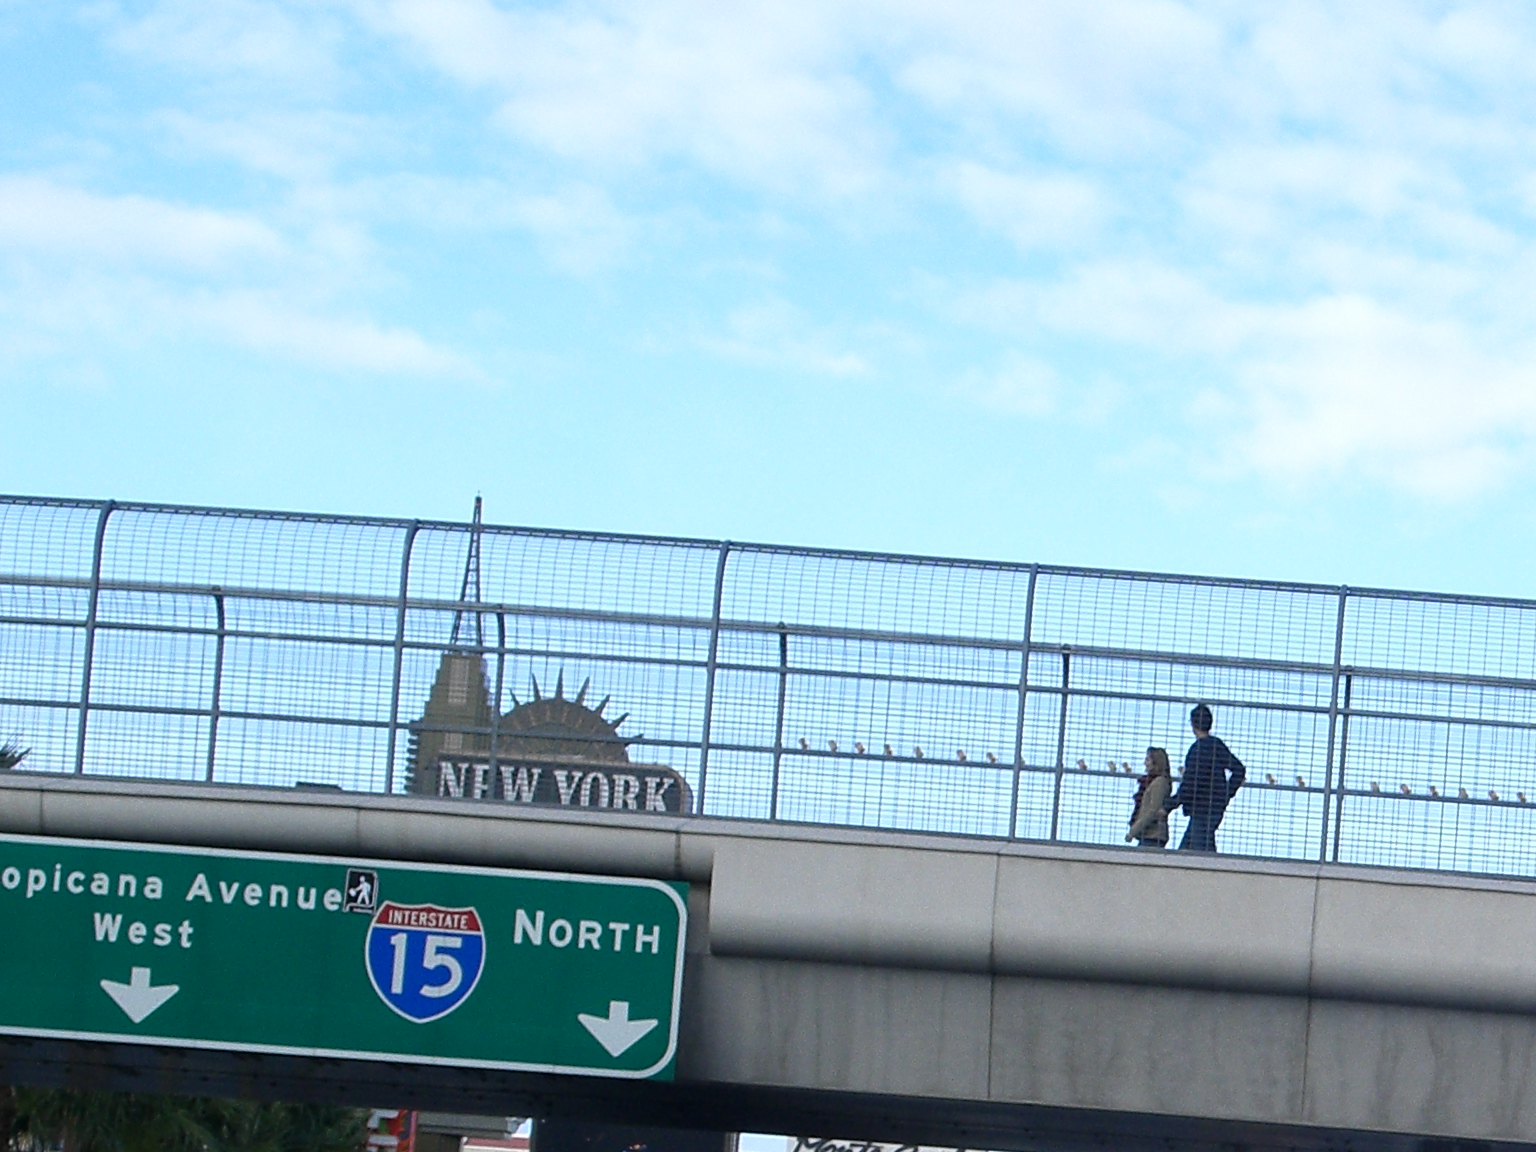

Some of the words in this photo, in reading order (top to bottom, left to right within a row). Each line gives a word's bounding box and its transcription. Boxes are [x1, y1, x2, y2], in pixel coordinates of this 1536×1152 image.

[438, 759, 542, 803] NEW
[553, 769, 675, 812] YORK
[1, 863, 163, 899] opicana
[185, 874, 342, 912] Avenue
[93, 912, 194, 949] West
[388, 909, 469, 929] INTERSTATE
[513, 910, 660, 954] NORTH
[390, 932, 463, 998] 15
